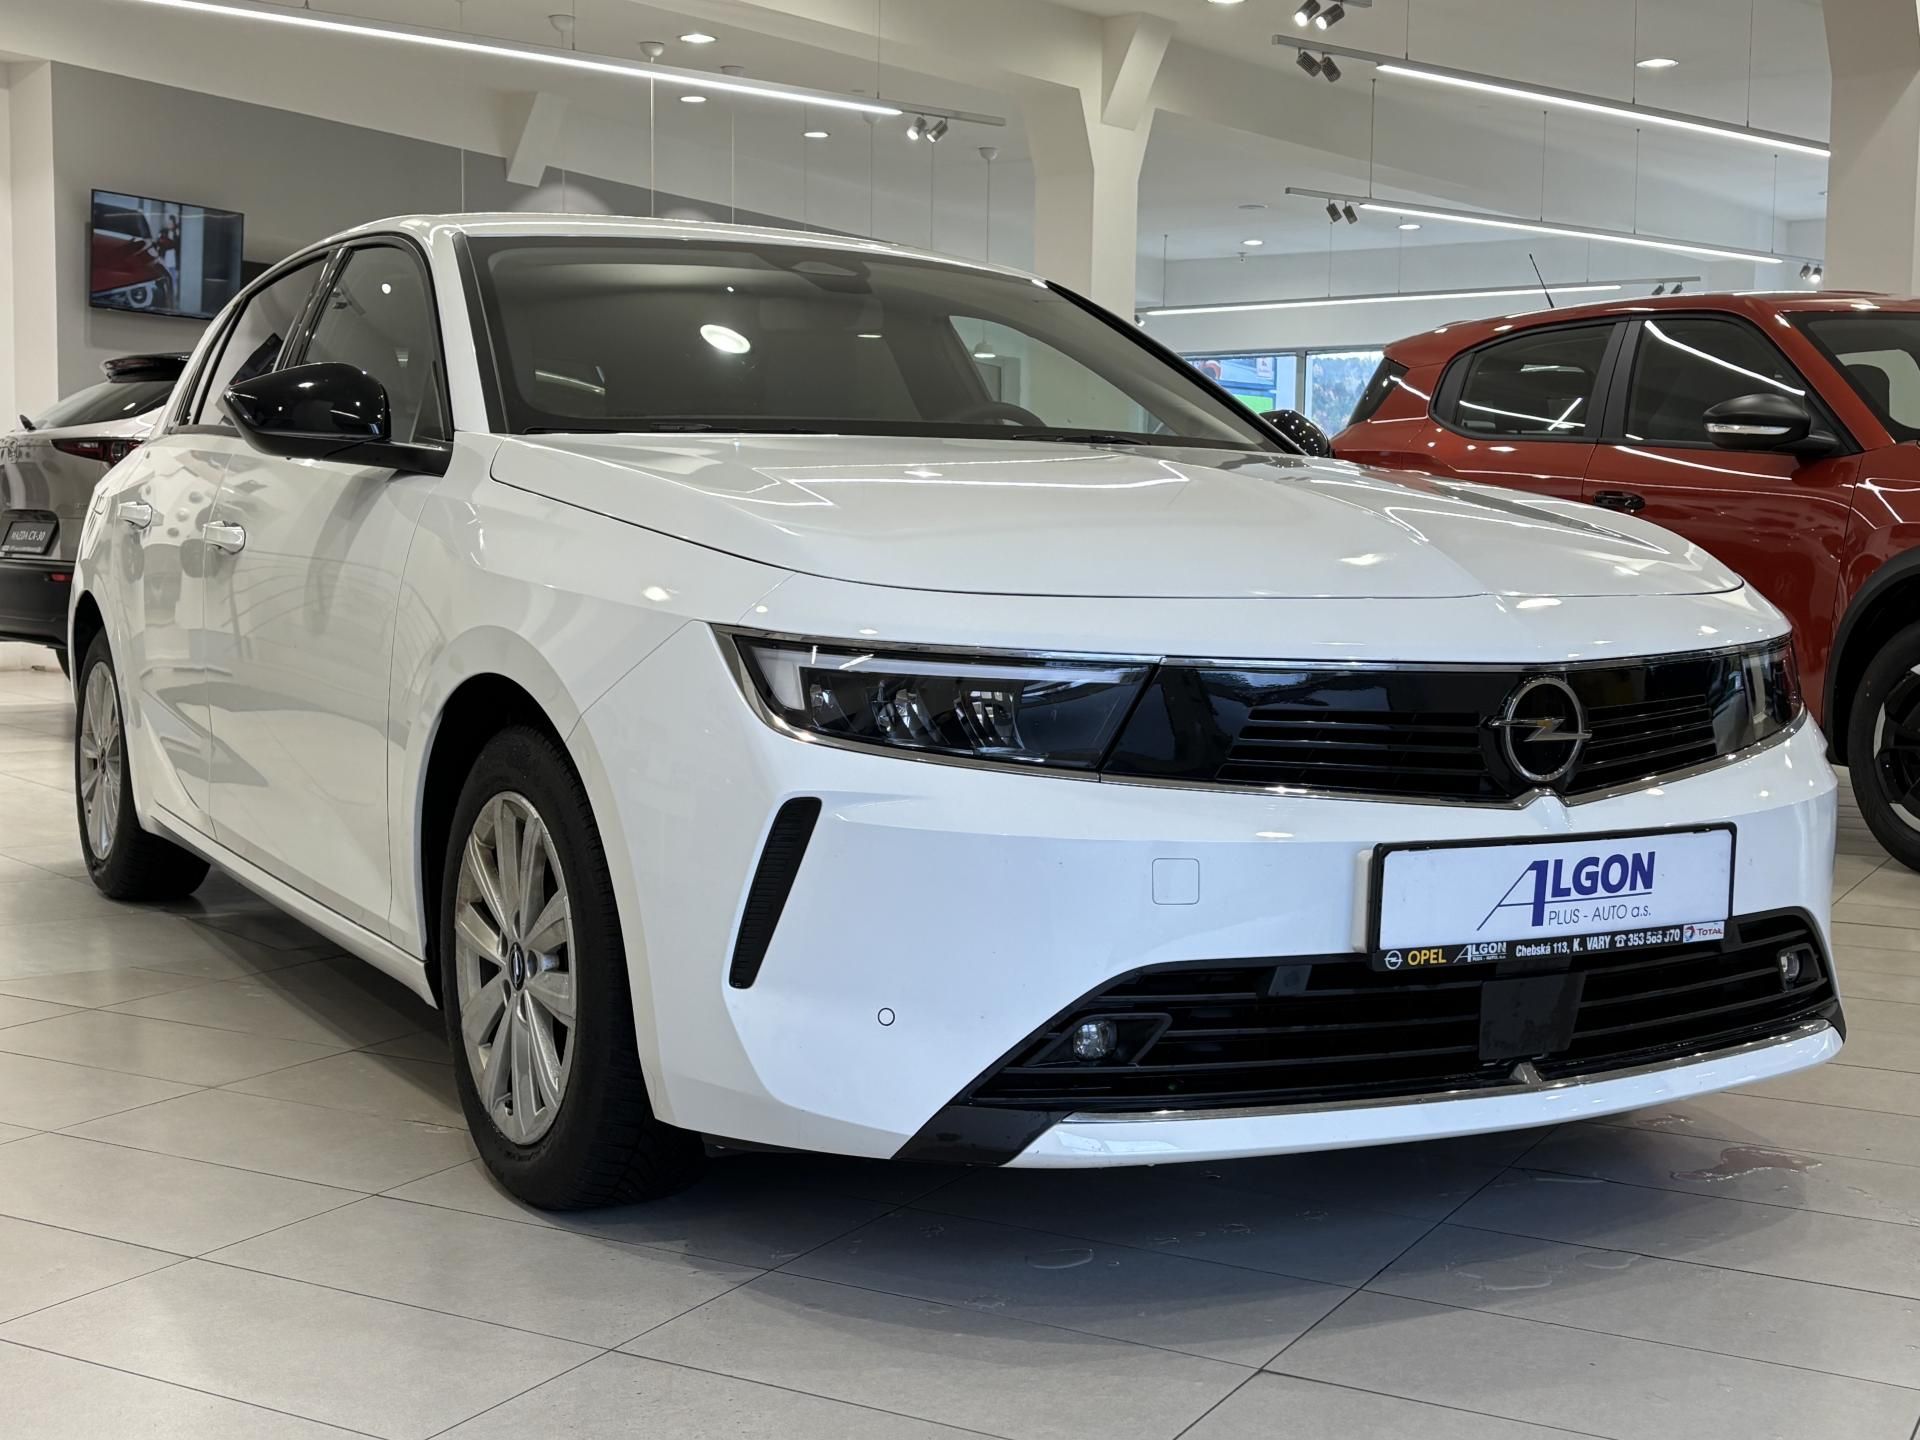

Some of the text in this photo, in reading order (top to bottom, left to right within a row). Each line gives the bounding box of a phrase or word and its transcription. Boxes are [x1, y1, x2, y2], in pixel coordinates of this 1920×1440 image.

[1477, 851, 1656, 931] ALGON
[1548, 908, 1580, 926] PLUS
[1591, 904, 1628, 922] AUTO
[1631, 905, 1652, 918] a.s.
[1698, 927, 1723, 937] TOTAL
[1452, 941, 1507, 963] ALGON
[1515, 942, 1551, 957] Chebská
[1572, 938, 1583, 952] K.
[1586, 935, 1611, 951] VARY
[1627, 932, 1644, 947] 353
[1407, 949, 1447, 966] OPEL
